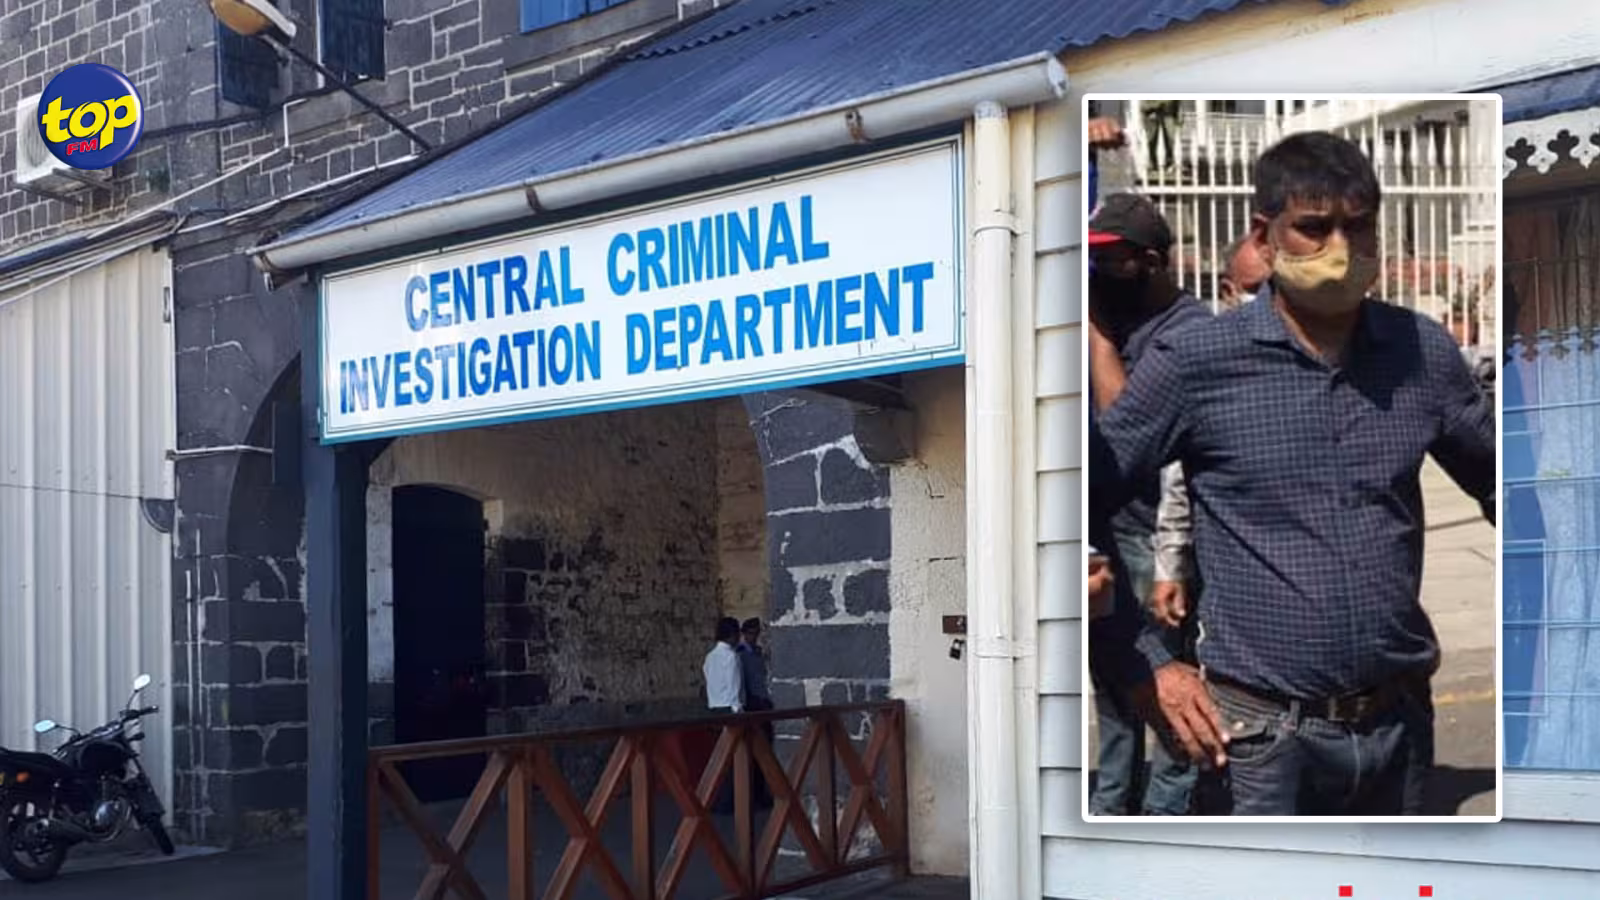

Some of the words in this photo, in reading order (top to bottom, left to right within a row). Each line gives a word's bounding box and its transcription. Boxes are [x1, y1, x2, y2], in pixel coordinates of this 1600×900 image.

[405, 246, 584, 331] CENTRAL
[607, 195, 830, 296] CRIMINAL
[339, 319, 600, 414] INVESTIGATION
[626, 262, 935, 376] DEPARTMENT
